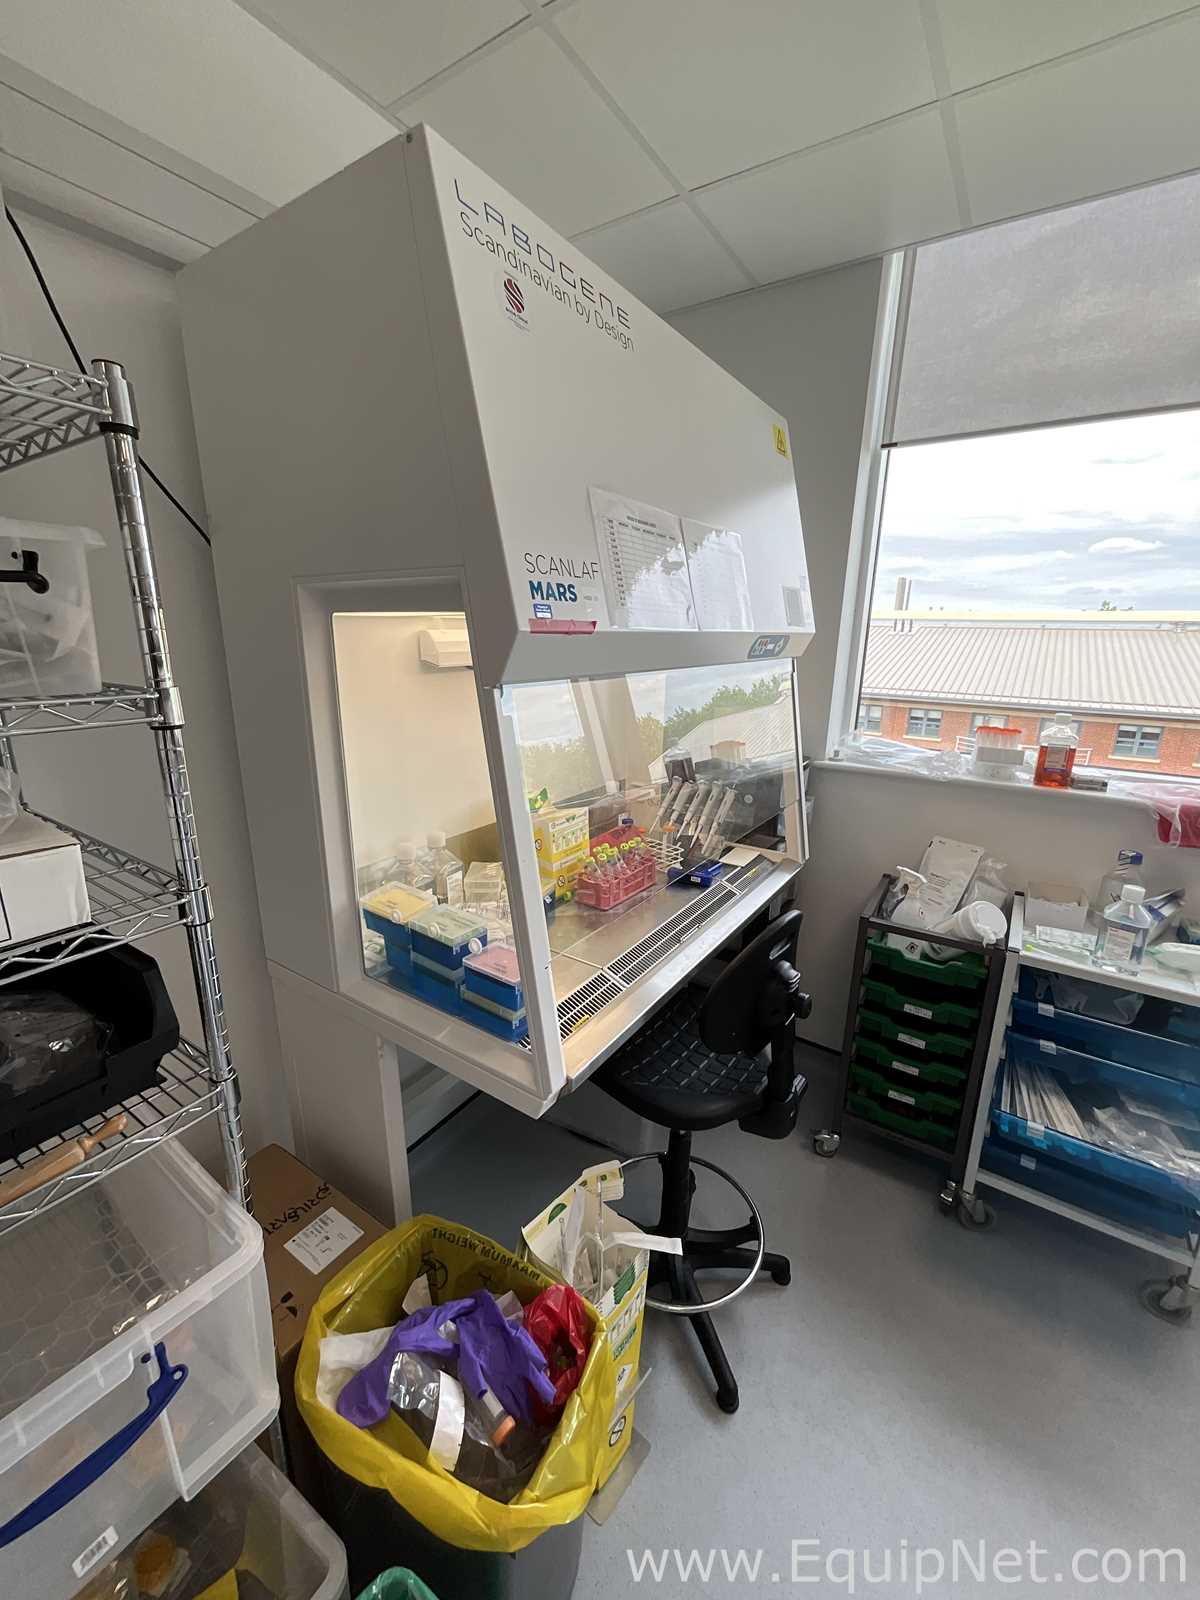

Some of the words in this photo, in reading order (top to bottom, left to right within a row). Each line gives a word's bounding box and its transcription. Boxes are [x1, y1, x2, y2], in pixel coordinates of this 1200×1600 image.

[454, 178, 631, 330] LABOGENE
[459, 210, 572, 309] Scandinavian
[574, 295, 592, 324] by
[594, 309, 635, 352] Design
[524, 552, 599, 580] SCANLAF
[528, 579, 577, 603] MARS
